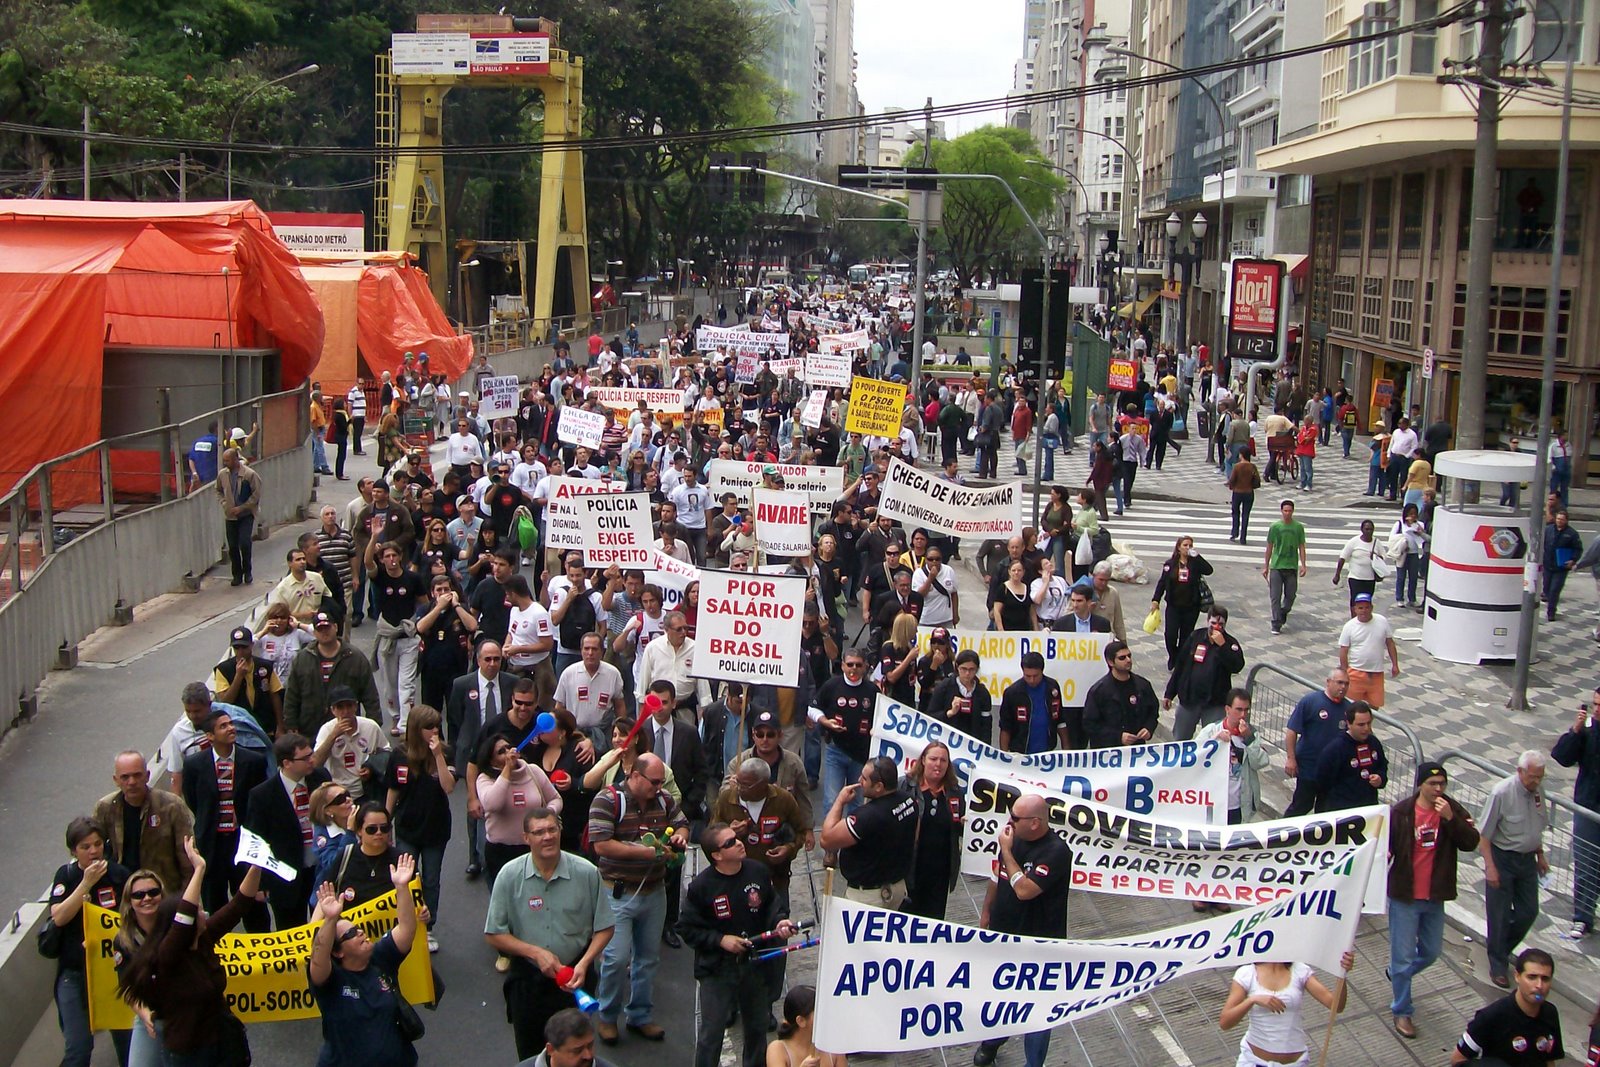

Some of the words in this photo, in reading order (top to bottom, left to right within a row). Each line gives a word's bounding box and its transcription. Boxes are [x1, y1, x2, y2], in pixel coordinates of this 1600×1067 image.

[280, 233, 312, 244] EXPANSÃO
[314, 235, 323, 244] DO
[325, 233, 347, 244] METRÔ
[1236, 274, 1272, 307] doril
[706, 331, 752, 340] POLICIAL
[756, 334, 779, 342] CIVIL
[1110, 364, 1134, 377] OURO
[624, 391, 644, 402] EXIGE
[647, 392, 680, 404] RESPEITO
[861, 383, 875, 391] POVO
[877, 384, 901, 396] ADVERTE
[495, 400, 511, 409] SIM
[860, 402, 899, 414] PREJUDICIAL
[869, 395, 894, 406] PSDB
[564, 409, 588, 420] CHEGA
[856, 420, 859, 428] E
[860, 420, 888, 432] SEGURANÇA
[1122, 424, 1148, 434] ORO
[748, 464, 807, 476] GOVNADOR
[720, 477, 753, 490] Punição
[798, 482, 826, 492] salário
[892, 464, 931, 494] CHEGA
[931, 484, 949, 502] DE
[949, 490, 973, 506] NOS
[560, 505, 570, 514] NA
[587, 496, 638, 512] POLÍCIA
[816, 502, 832, 511] pag
[598, 516, 630, 528] CIVIL
[757, 503, 808, 525] AVARÉ
[885, 498, 901, 513] COM
[901, 503, 906, 514] A
[907, 504, 943, 526] CONVERSA
[943, 518, 954, 531] DA
[553, 519, 581, 530] DIGNIDA
[551, 534, 560, 543] DA
[562, 534, 583, 545] POLÍC
[598, 532, 635, 545] EXIGE
[782, 542, 810, 551] SALARIAL
[589, 549, 648, 562] RESPEITO
[653, 553, 662, 570] E
[728, 579, 776, 597] PIOR
[706, 598, 794, 619] SALÁRIO
[734, 621, 762, 636] DO
[710, 639, 782, 659] BRASIL
[911, 632, 931, 655] IO
[950, 633, 1015, 659] SALÁRIO
[1020, 637, 1042, 659] DO
[1047, 638, 1101, 660] BRASIL
[719, 658, 756, 674] POLÍCIA
[759, 664, 784, 676] CIVIL
[883, 704, 942, 742] Sabe
[879, 739, 917, 769] PI
[1126, 776, 1214, 815] BRASIL
[1045, 797, 1367, 851] GOVERNADOR
[971, 818, 998, 835] OS
[1051, 828, 1115, 849] CIAIS
[1123, 844, 1210, 861] PEDEM
[1218, 850, 1352, 870] REPOSIÇ
[1096, 855, 1201, 878] APARTIR
[1212, 865, 1247, 882] DA
[1259, 867, 1315, 885] DAT
[1072, 871, 1103, 887] DE
[1112, 875, 1129, 889] 1º
[1138, 878, 1174, 894] DE
[233, 939, 245, 948] A
[346, 907, 373, 922] VIL
[376, 889, 423, 911] QUR
[246, 944, 308, 960] PODER
[262, 958, 298, 975] POR
[833, 958, 934, 996] APOIA
[947, 962, 970, 988] A
[992, 961, 1106, 991] GREVE
[900, 1002, 964, 1040] POR
[980, 1002, 1035, 1028] UM
